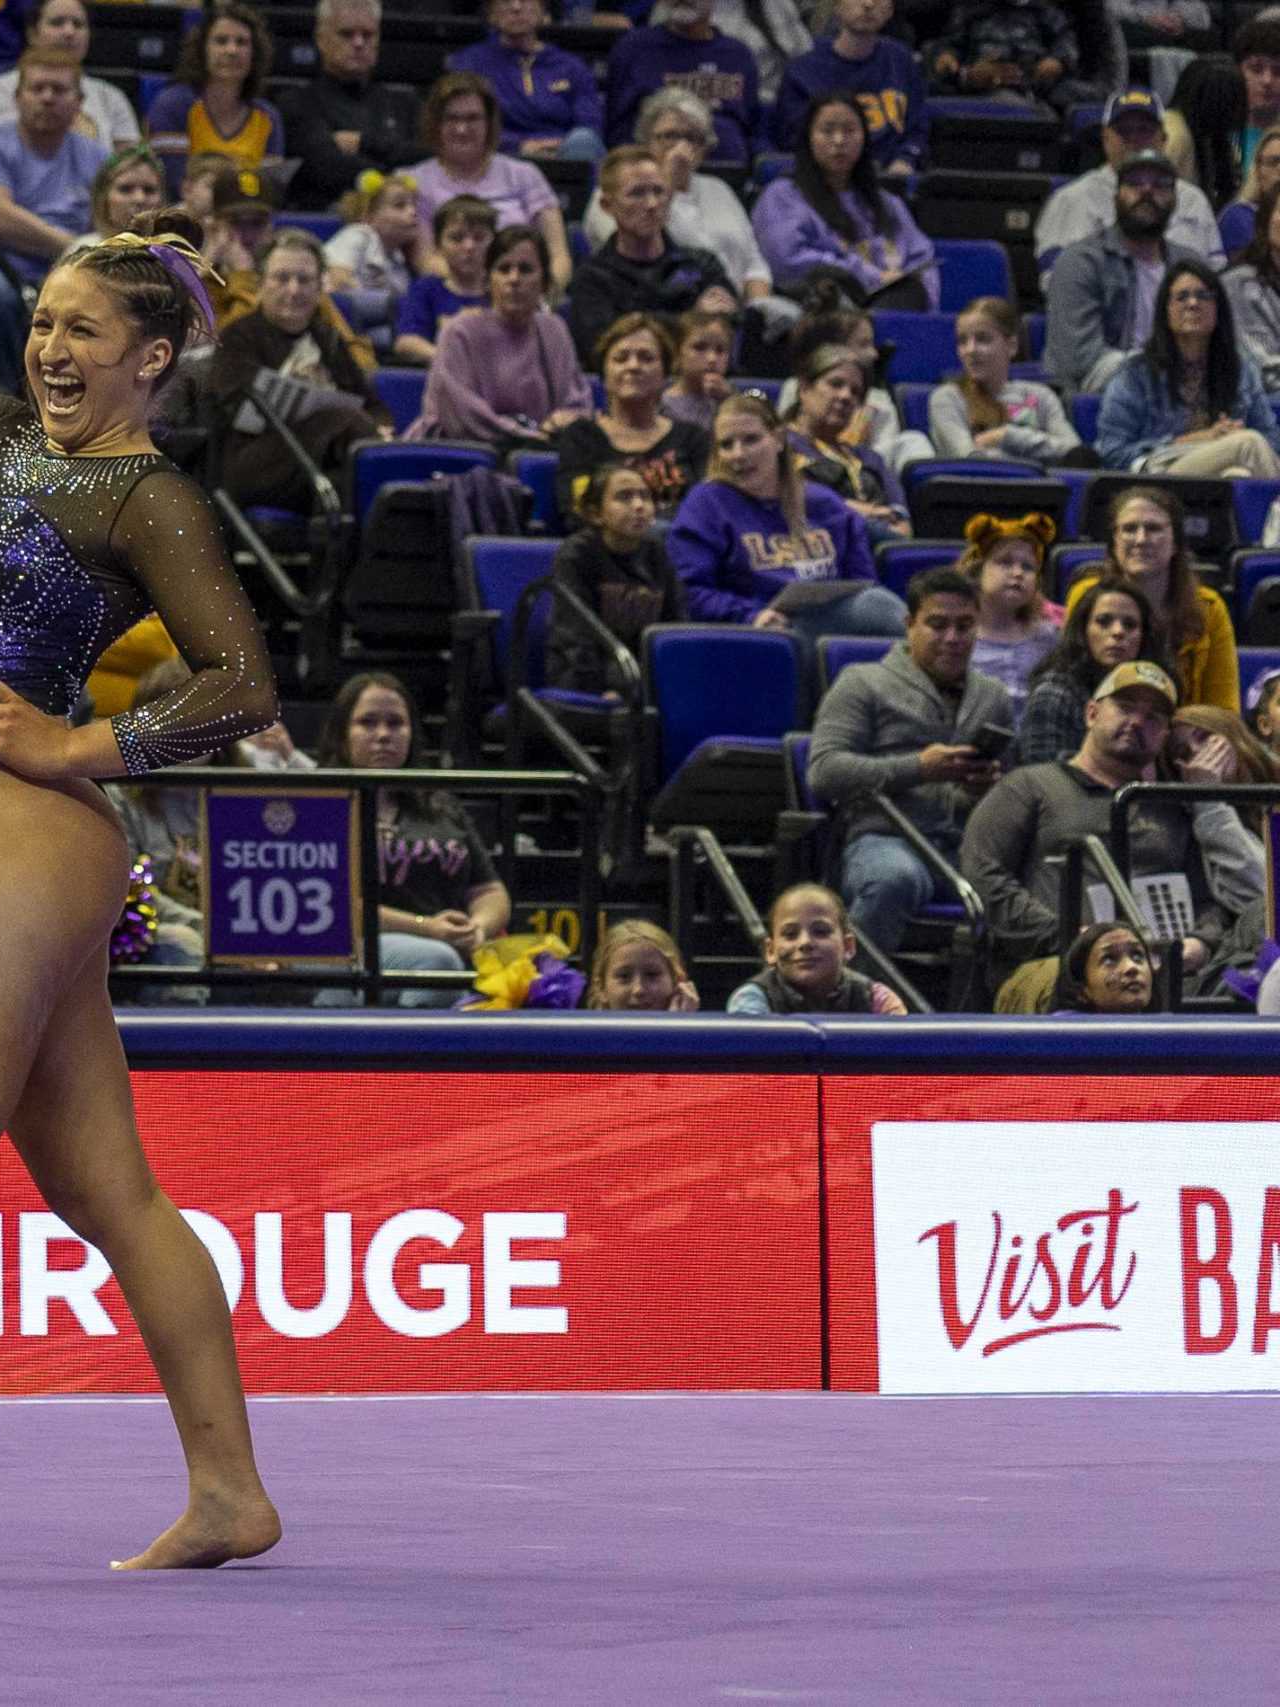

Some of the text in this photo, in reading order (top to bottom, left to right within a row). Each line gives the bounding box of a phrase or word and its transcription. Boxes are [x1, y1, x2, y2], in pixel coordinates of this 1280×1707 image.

[741, 530, 837, 571] LSU
[223, 840, 338, 870] SECTION
[228, 877, 335, 935] 103
[528, 909, 579, 954] 10
[918, 1188, 1140, 1352] Visit
